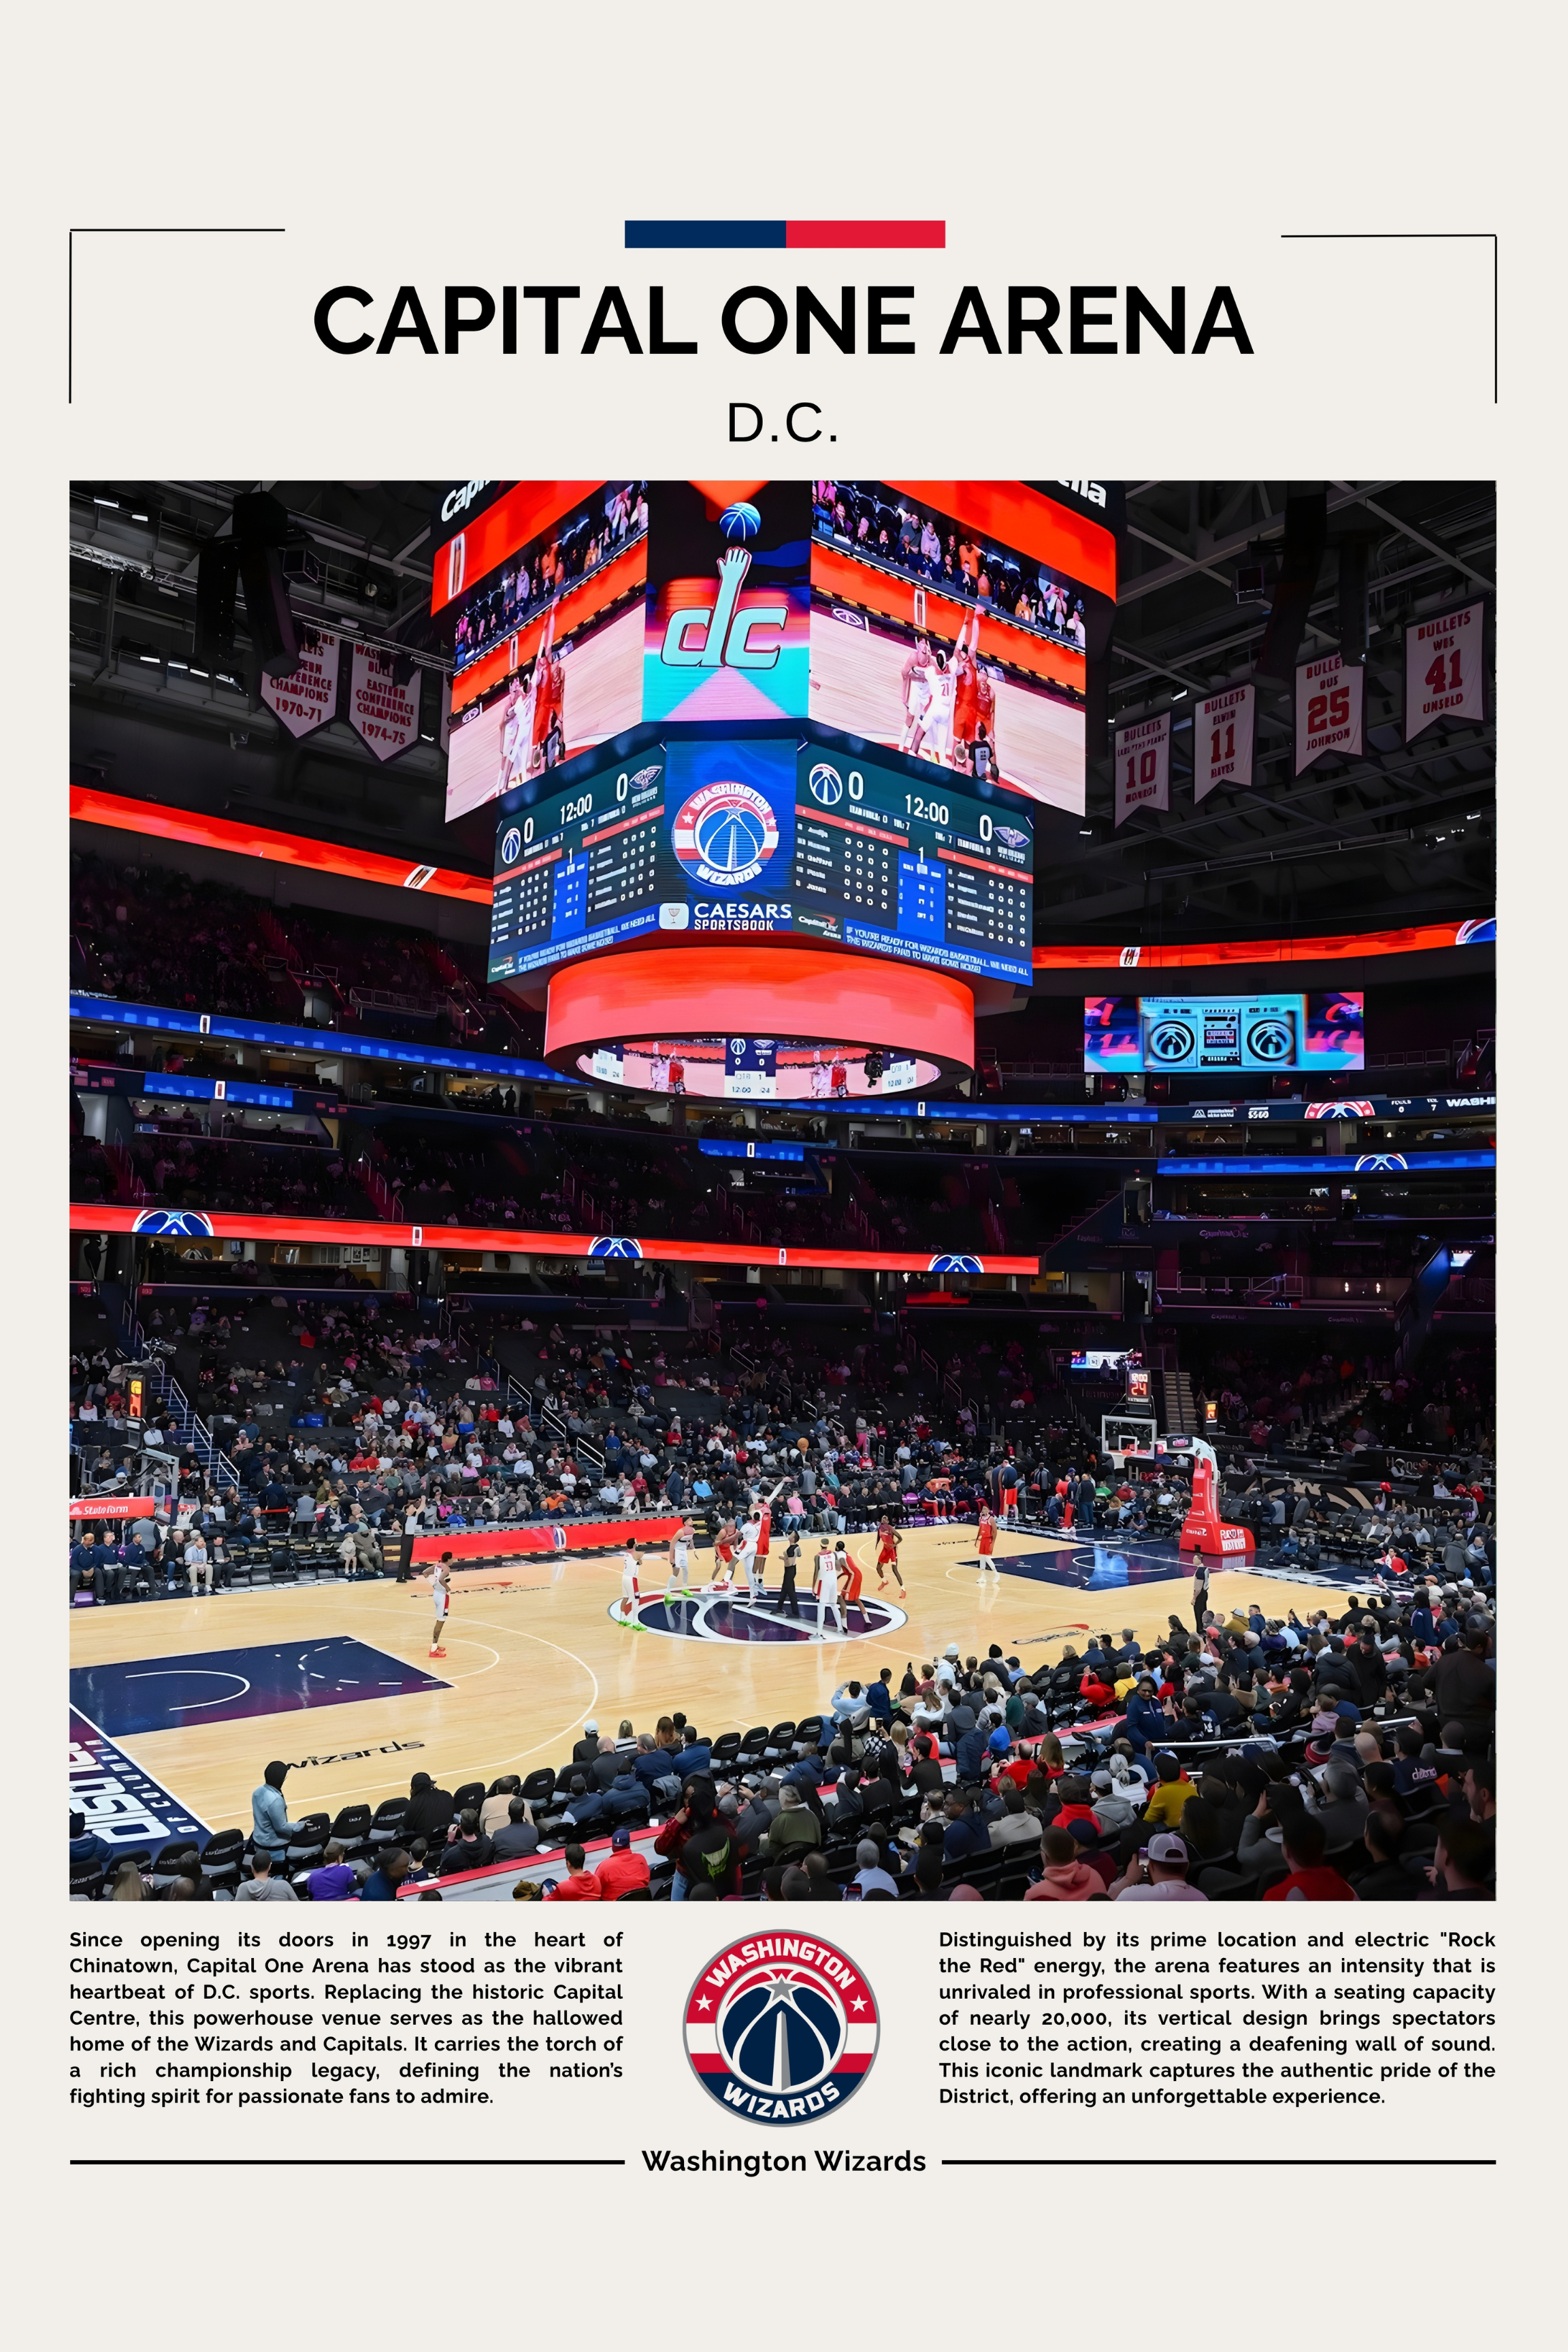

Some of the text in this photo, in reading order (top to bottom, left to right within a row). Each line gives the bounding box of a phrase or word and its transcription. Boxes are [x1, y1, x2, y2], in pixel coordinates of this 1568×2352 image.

[1425, 649, 1463, 695] 41
[276, 697, 322, 723] 1970-71
[1307, 685, 1350, 735] 25
[362, 721, 406, 745] 1974-75
[1211, 723, 1236, 764] 11
[1126, 749, 1156, 789] 10
[617, 773, 628, 802] 0
[848, 771, 864, 800] 0
[560, 793, 593, 825] 12:00
[905, 794, 949, 825] 12:00
[523, 817, 534, 844] 0
[979, 815, 993, 842] 0
[696, 862, 762, 885] WIZARDS
[694, 903, 792, 919] CAESARS
[694, 919, 774, 931] SPORTSBOOK
